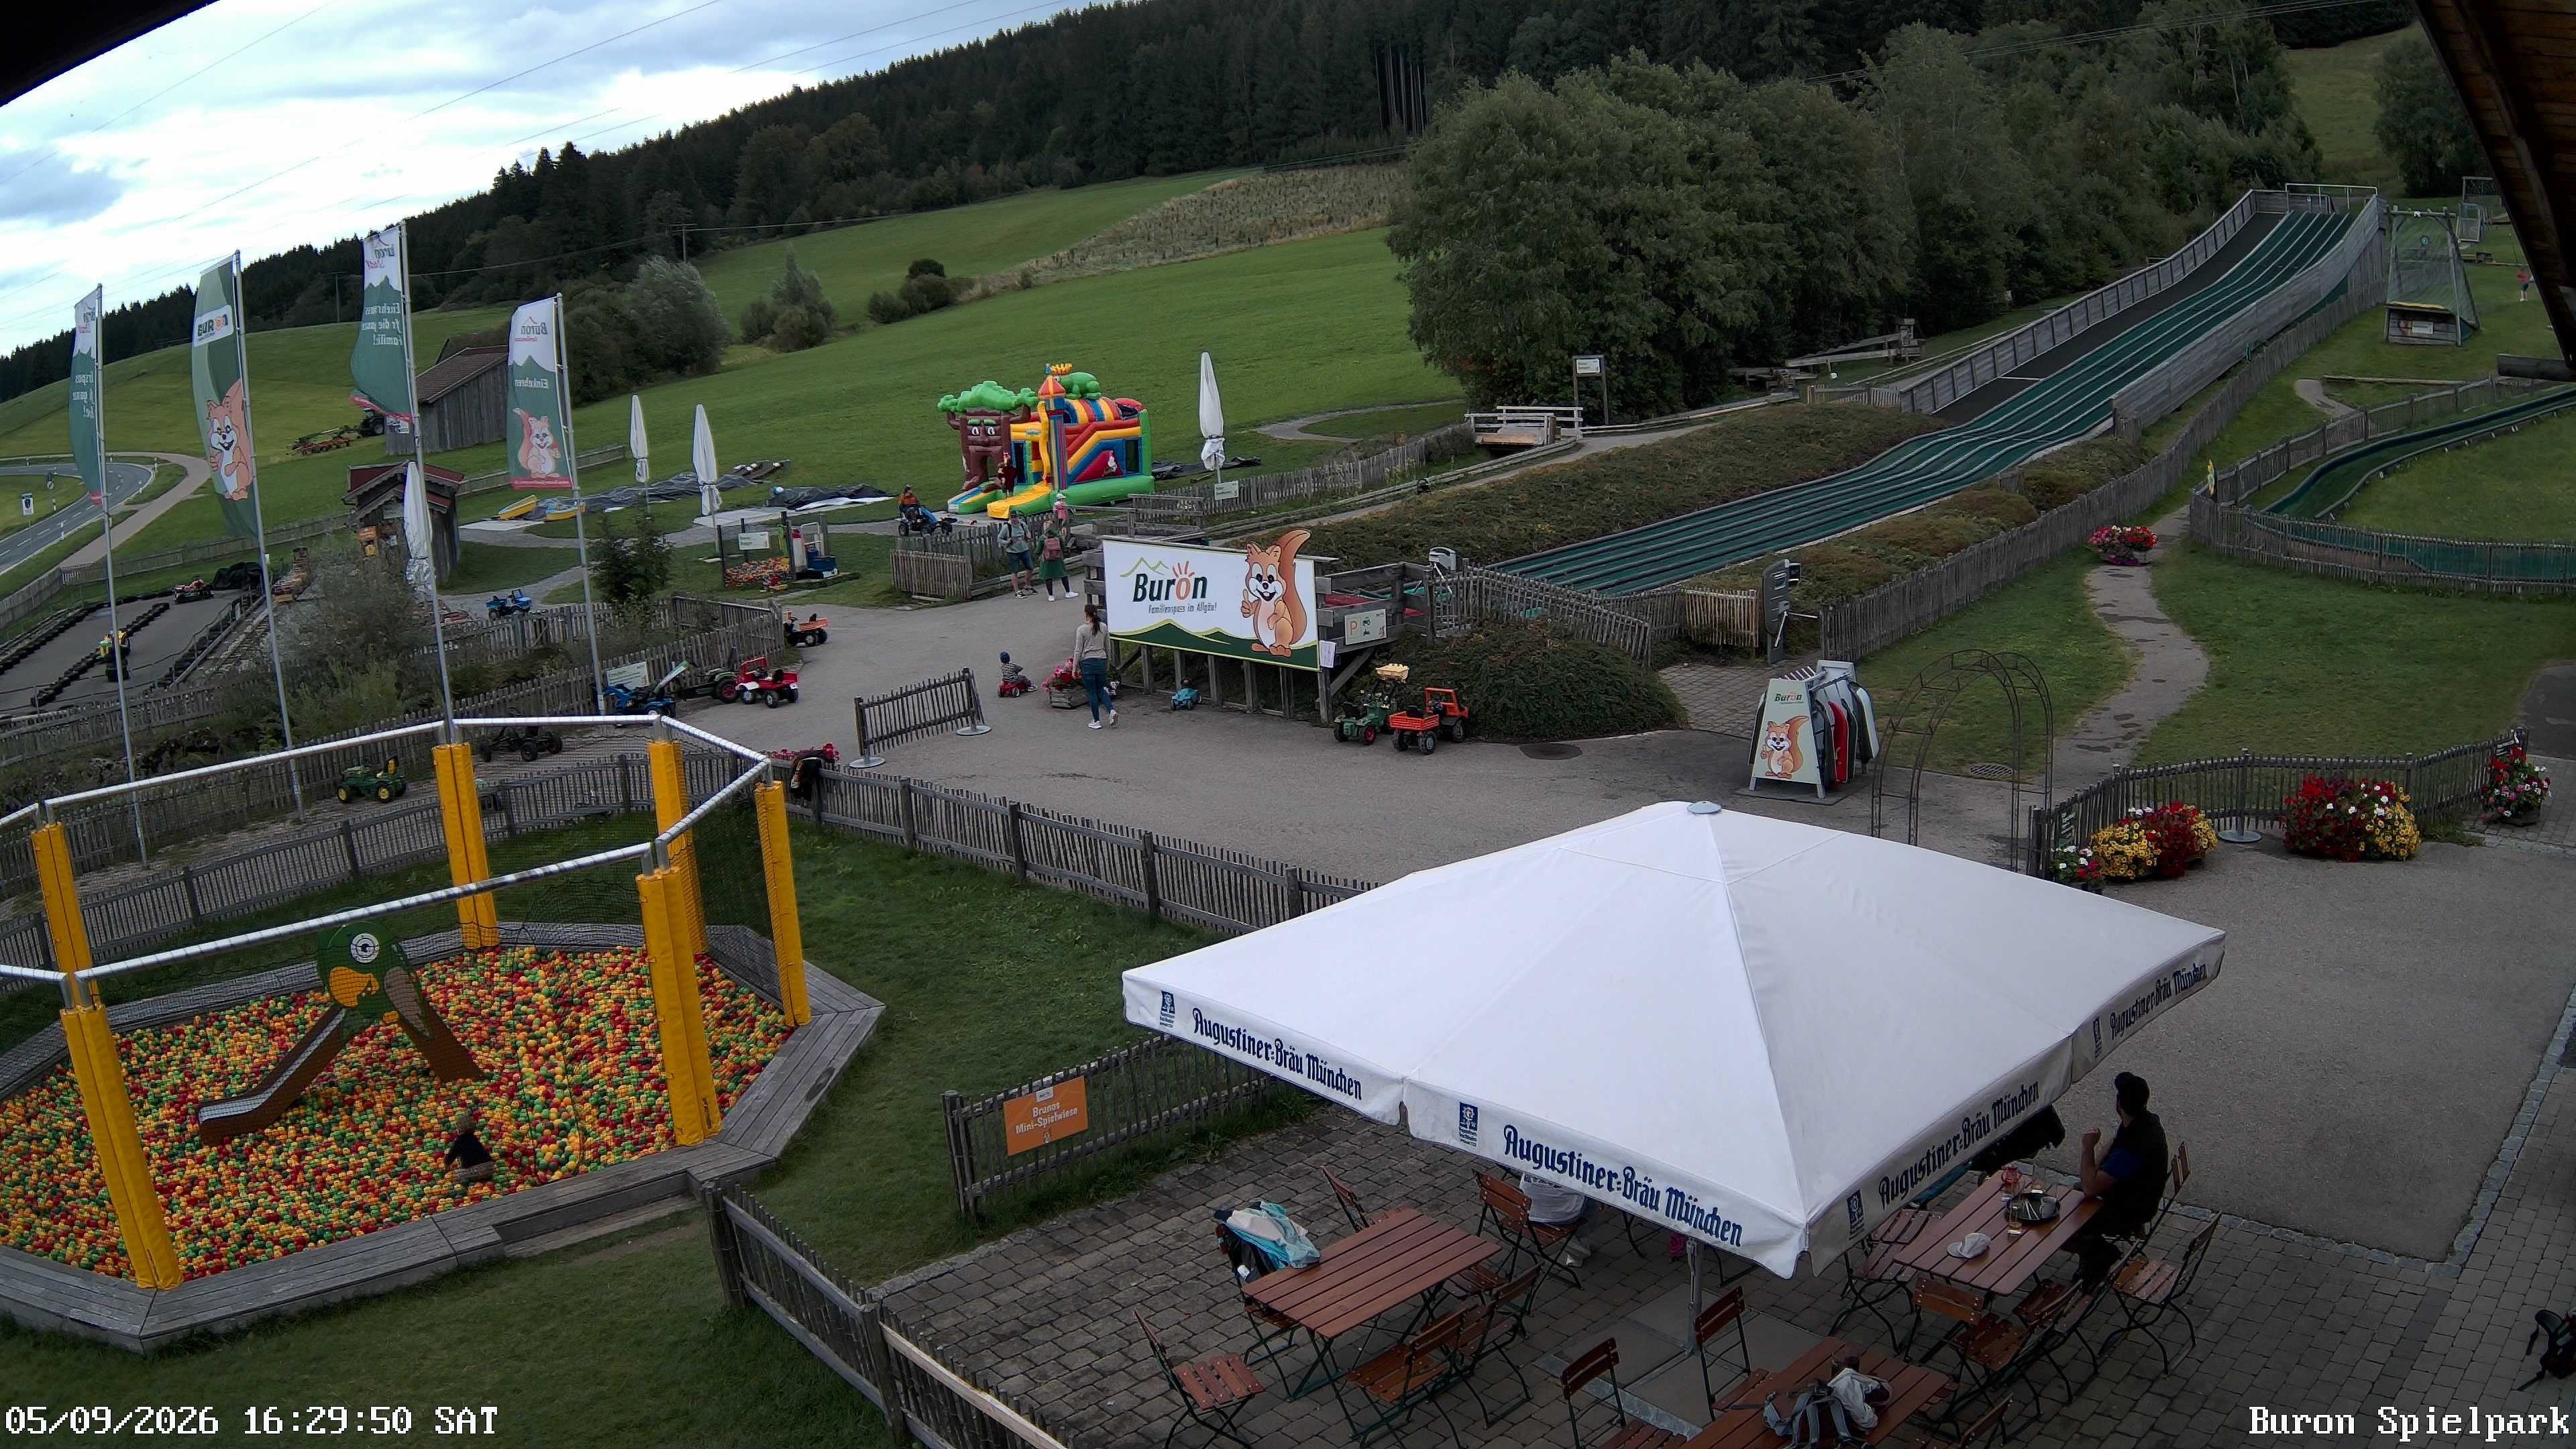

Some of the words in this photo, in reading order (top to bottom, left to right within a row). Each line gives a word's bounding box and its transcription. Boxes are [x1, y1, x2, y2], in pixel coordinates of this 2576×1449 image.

[1132, 573, 1208, 602] Buron
[1350, 620, 1358, 636] P
[1305, 1053, 1362, 1101] München
[1032, 1102, 1061, 1117] Brunos
[1991, 1081, 2039, 1128] München
[1016, 1108, 1078, 1134] Mini-Spielwiese
[1665, 1186, 1742, 1248] München
